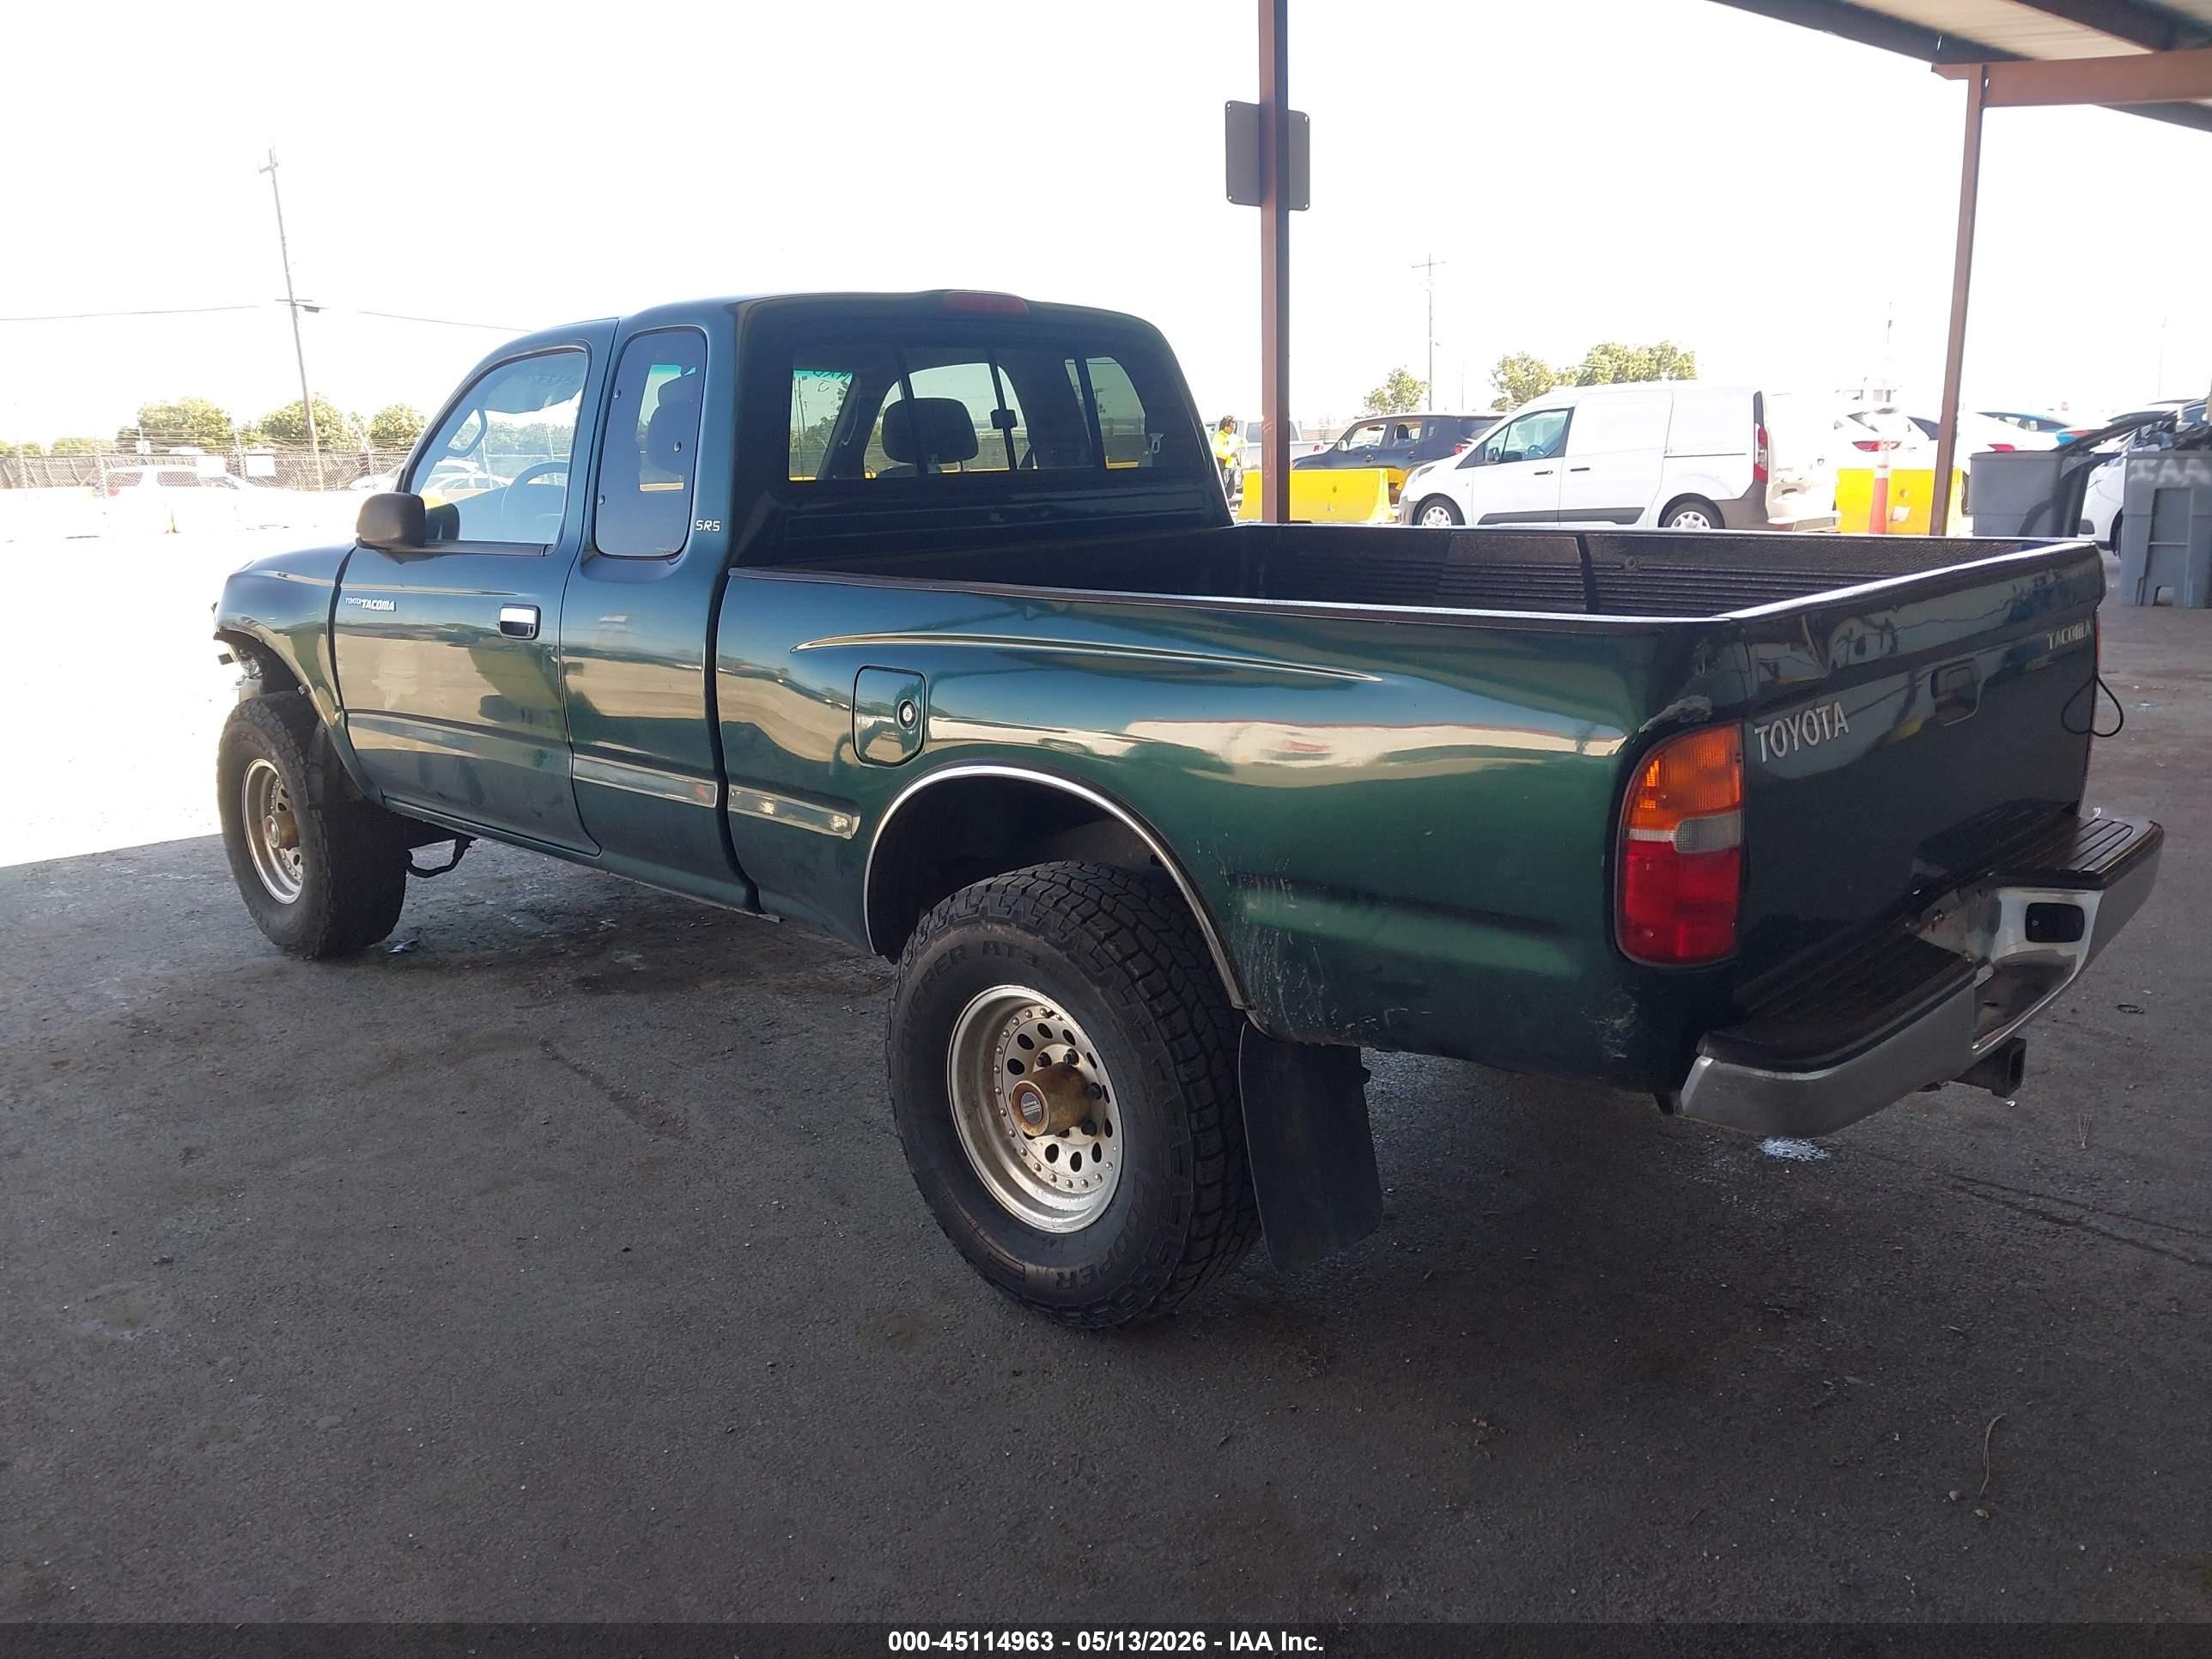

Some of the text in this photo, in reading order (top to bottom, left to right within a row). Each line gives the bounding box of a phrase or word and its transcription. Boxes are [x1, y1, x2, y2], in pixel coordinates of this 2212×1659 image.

[361, 599, 395, 611] TACOMA
[2046, 620, 2092, 651] TACOMA
[1753, 701, 1850, 763] TOYOTA
